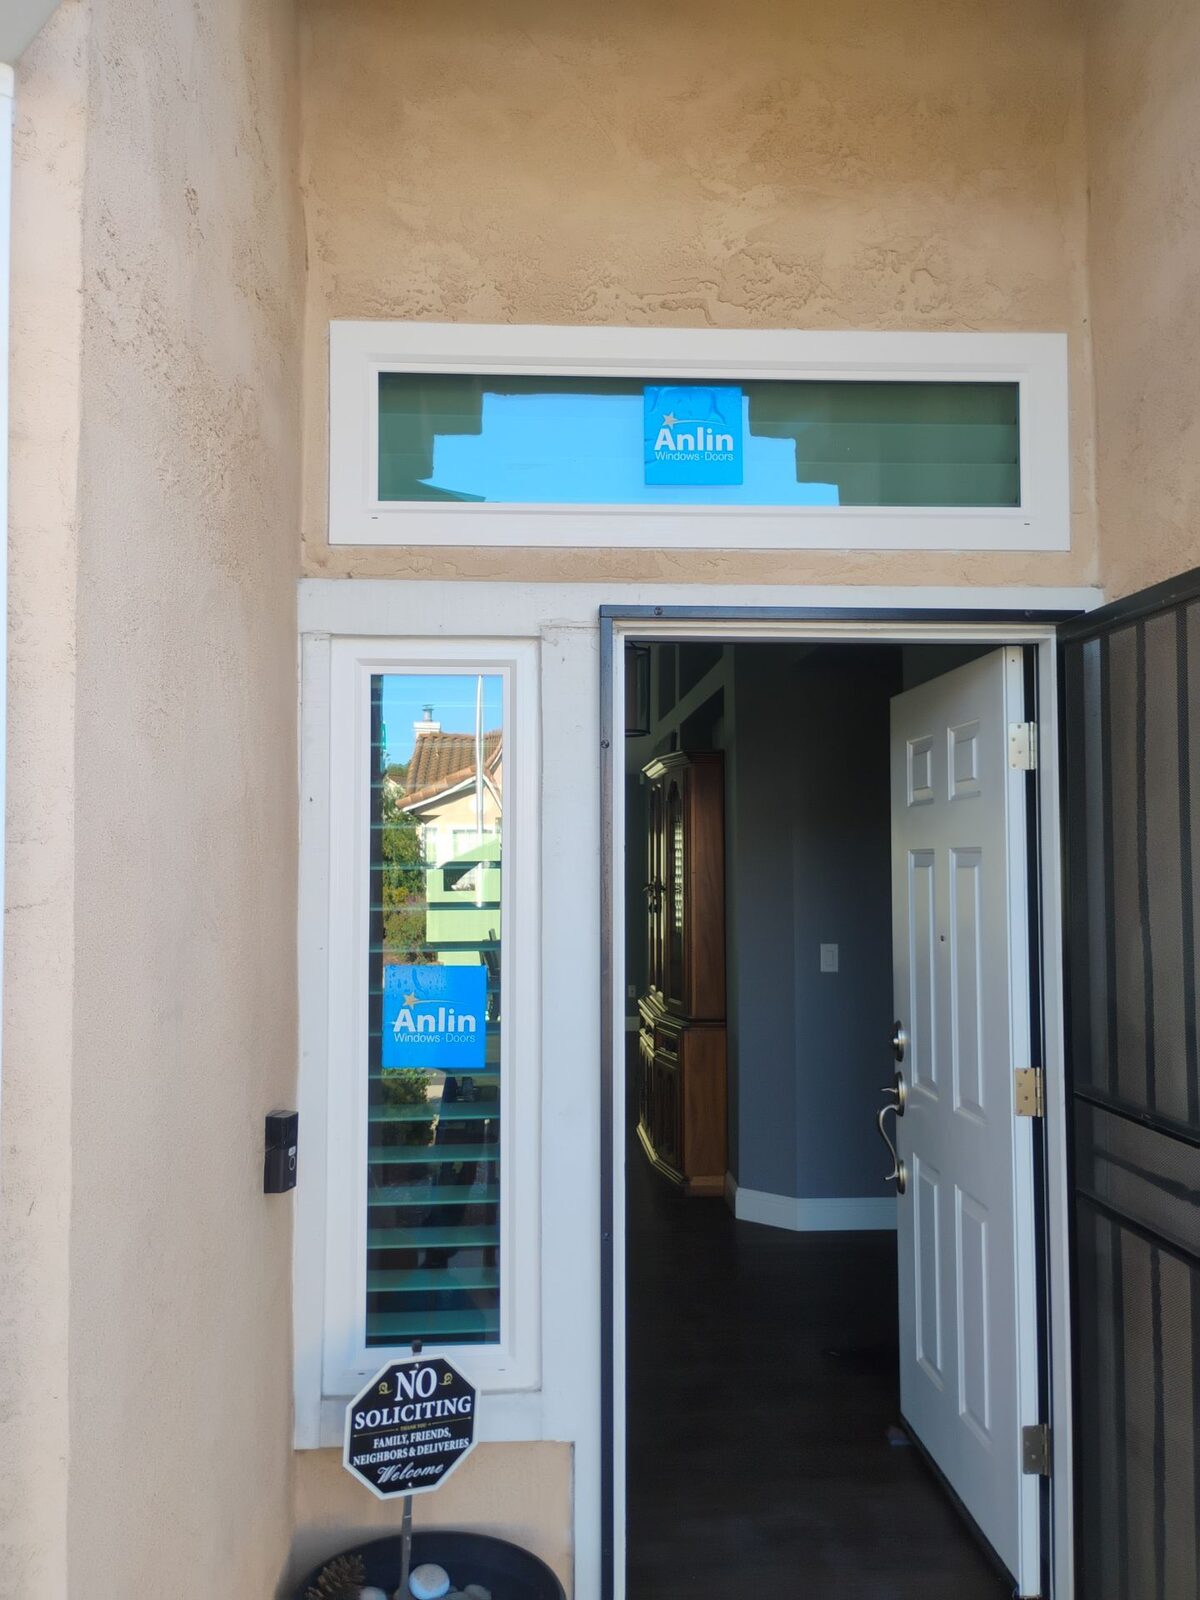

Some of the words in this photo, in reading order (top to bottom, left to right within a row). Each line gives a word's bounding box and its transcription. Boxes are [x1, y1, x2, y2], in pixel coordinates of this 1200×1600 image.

[654, 427, 734, 451] Anlin
[393, 1007, 476, 1032] Anlin
[394, 1368, 437, 1401] NO
[355, 1396, 471, 1429] SOLICITING
[374, 1434, 409, 1449] FAMILY,
[411, 1427, 452, 1443] FRIENDS,
[353, 1447, 408, 1466] NEIGHBORS
[409, 1448, 416, 1457] &
[416, 1438, 470, 1456] DELIVERIES
[377, 1462, 444, 1484] Welcome
